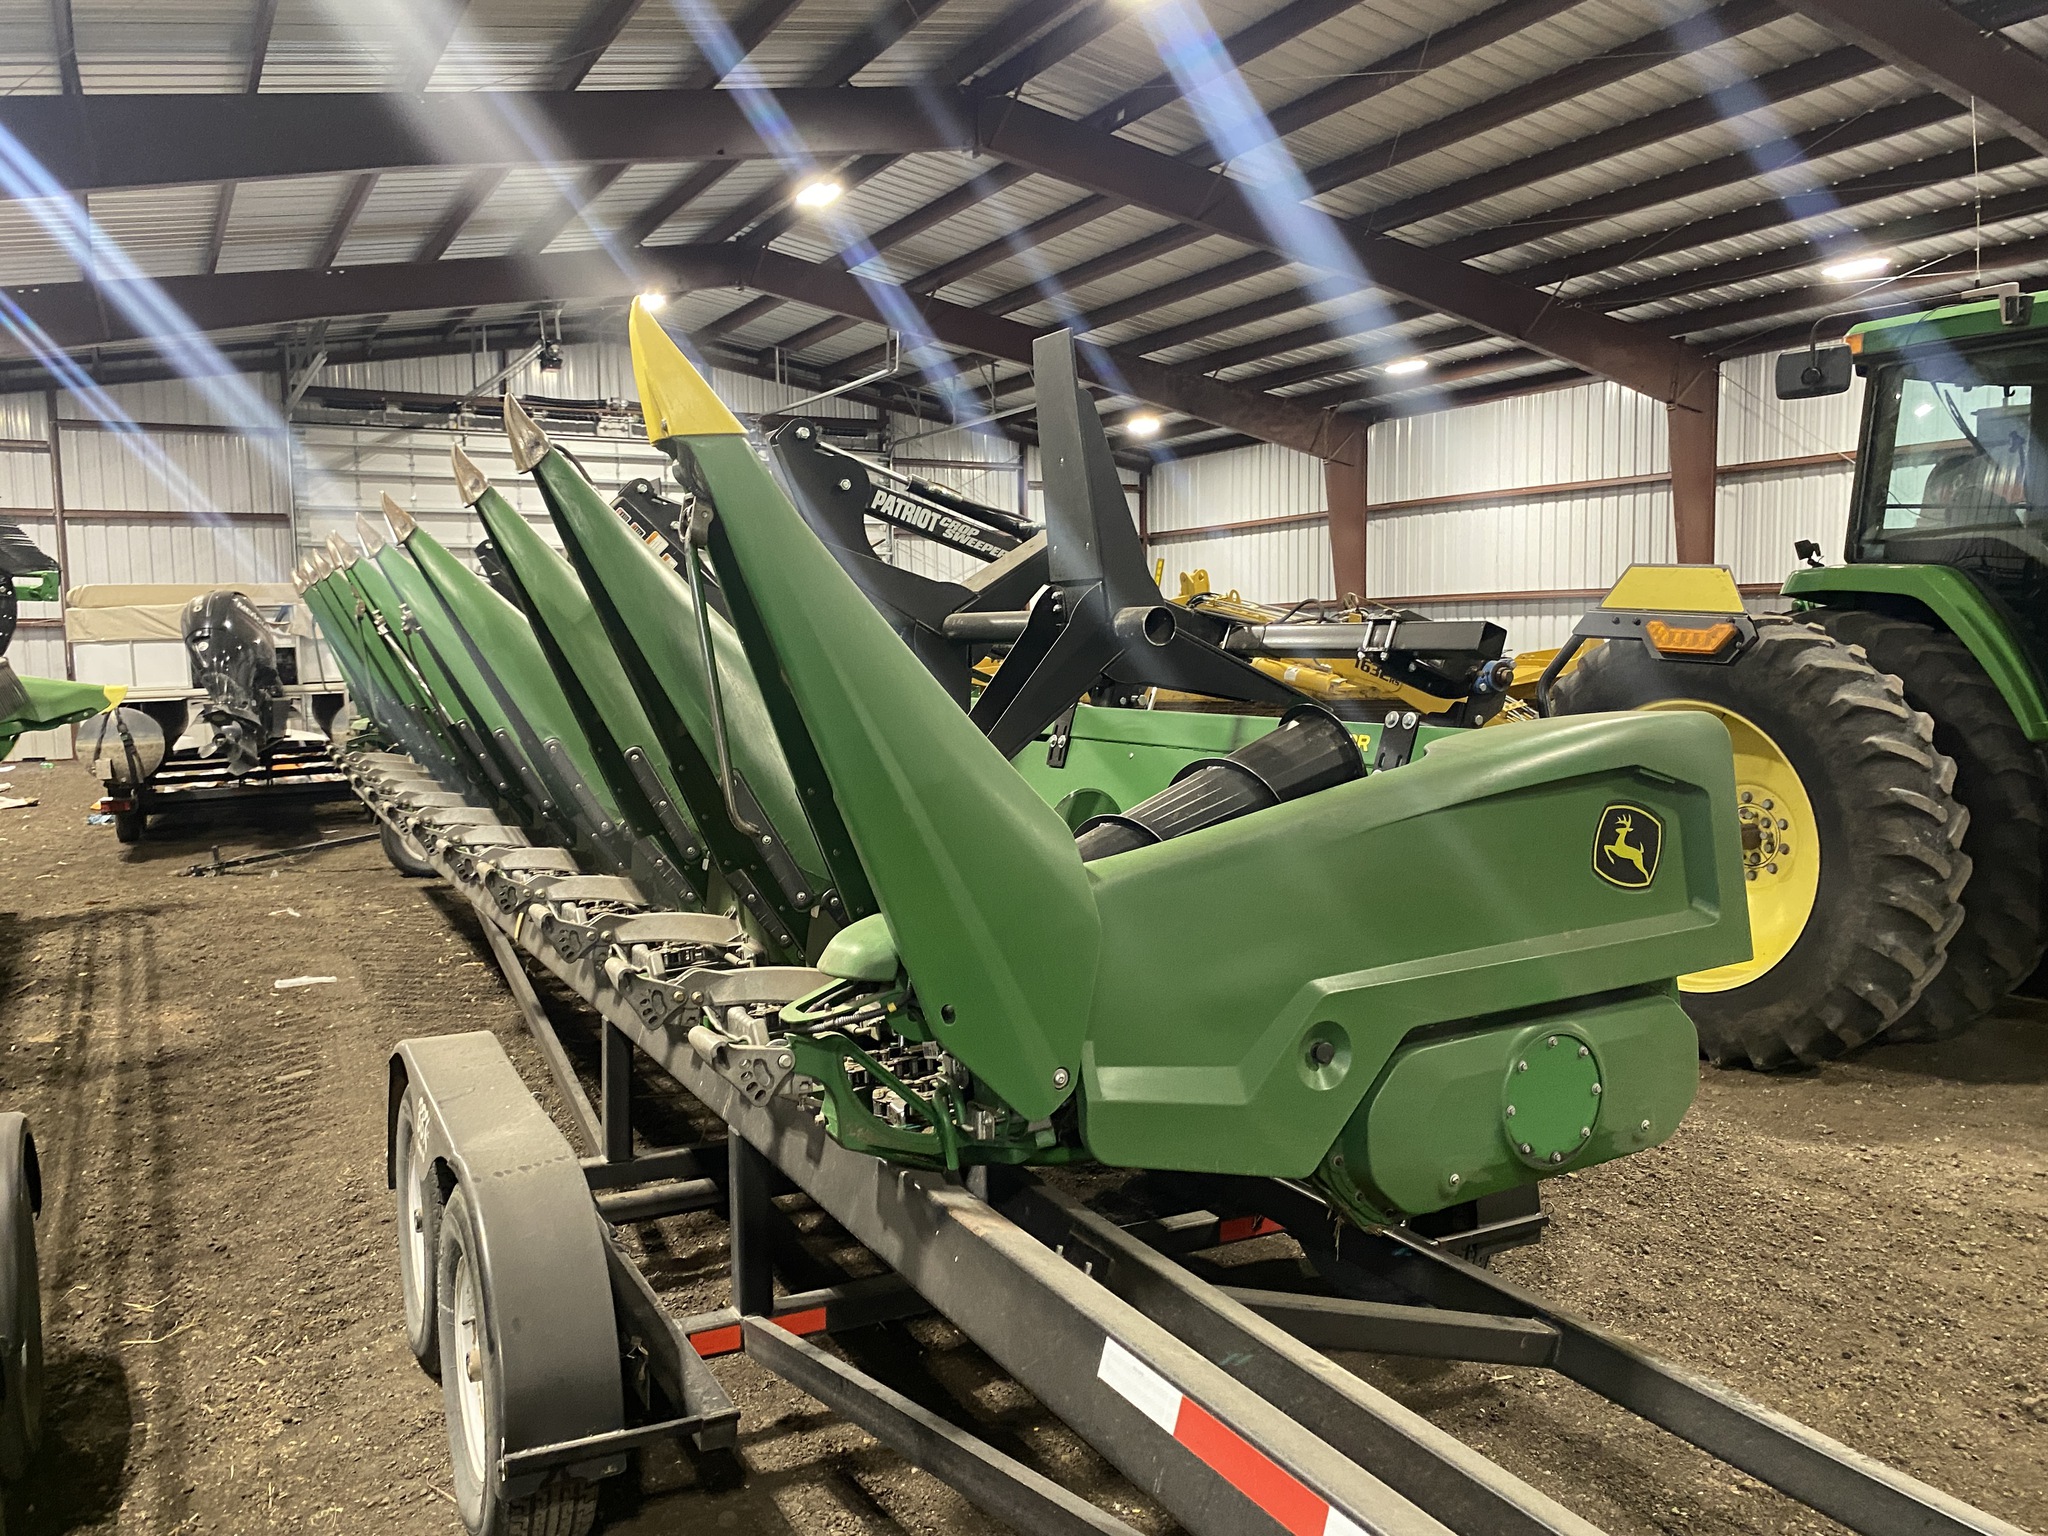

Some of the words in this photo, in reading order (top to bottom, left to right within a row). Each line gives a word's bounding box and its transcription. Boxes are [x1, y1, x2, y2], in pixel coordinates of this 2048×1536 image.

[871, 489, 941, 532] PATRIOT
[939, 516, 981, 537] CROP
[942, 528, 1007, 558] SWEEPER
